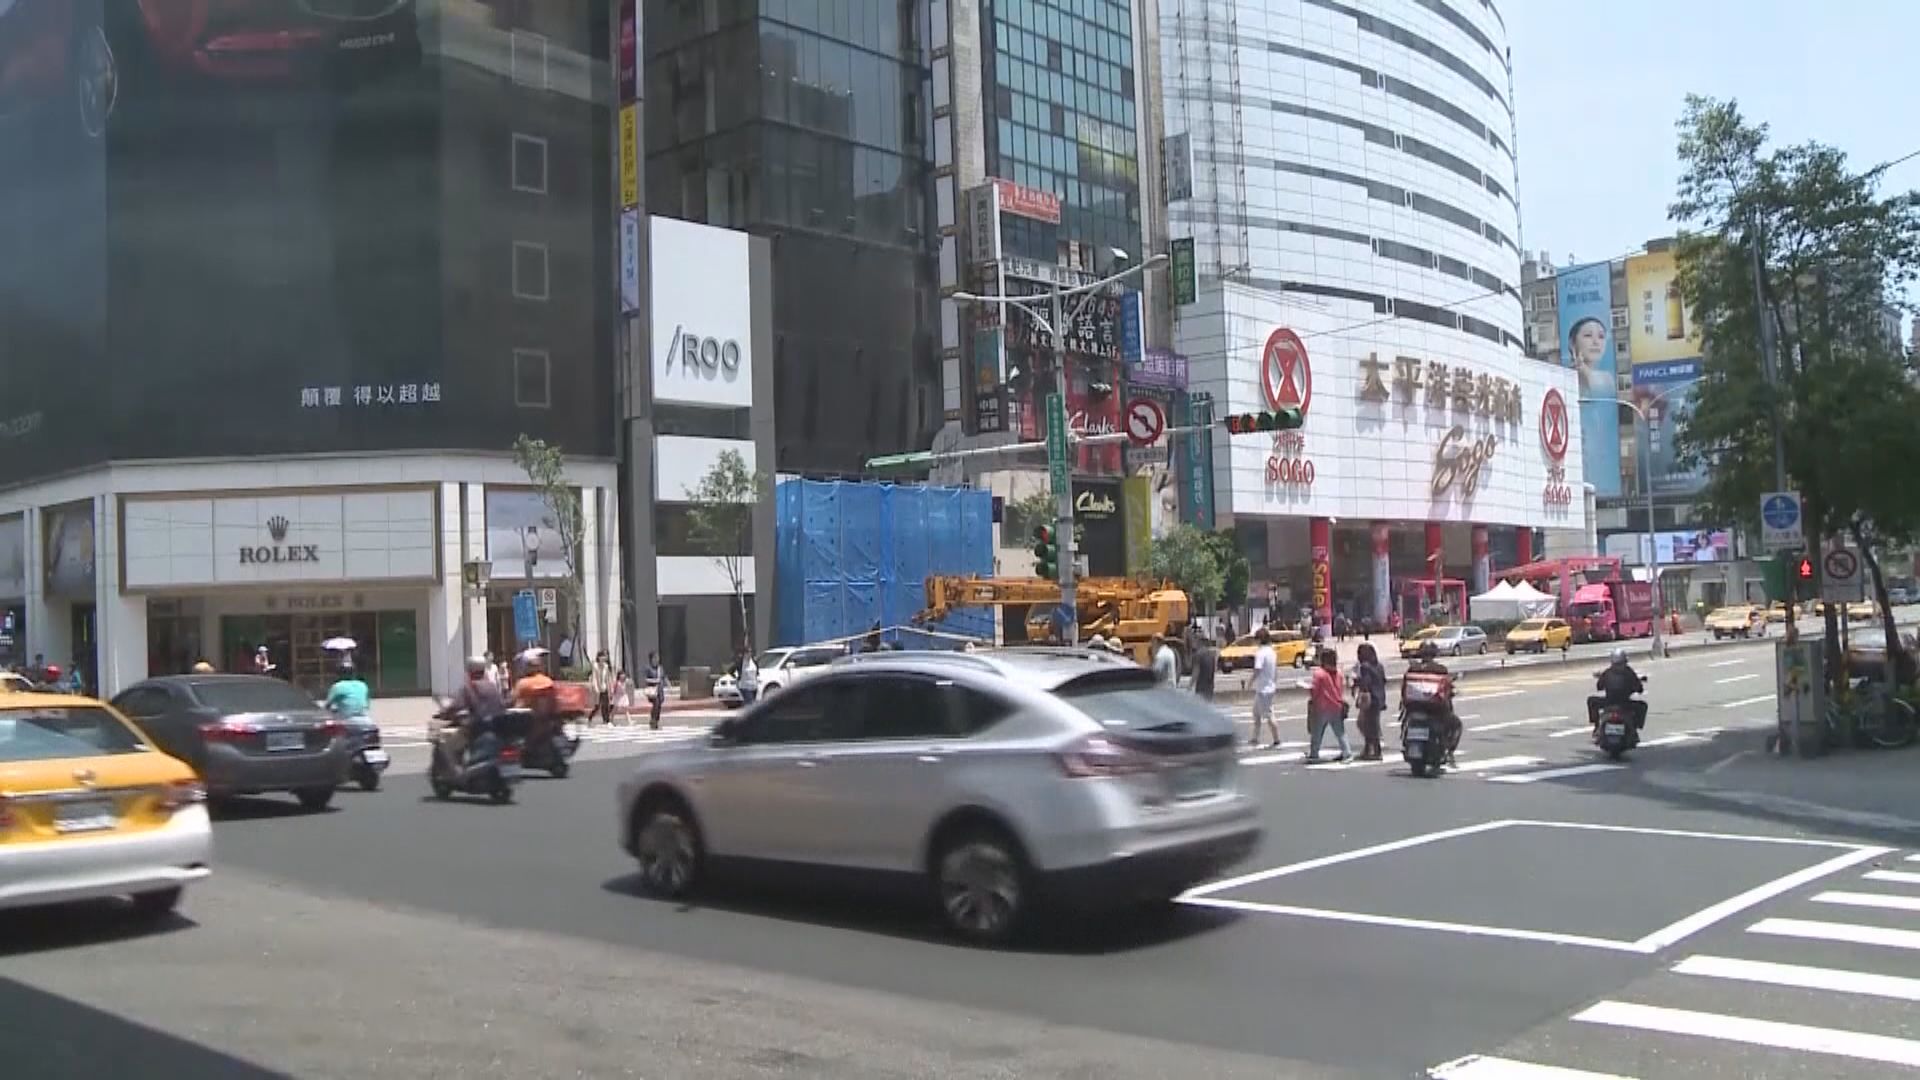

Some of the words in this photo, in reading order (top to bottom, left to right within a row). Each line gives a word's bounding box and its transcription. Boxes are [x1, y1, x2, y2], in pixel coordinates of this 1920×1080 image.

[300, 387, 342, 406] 顛覆
[354, 383, 441, 405] 得以超越
[1068, 411, 1116, 435] Clarks
[1267, 456, 1315, 484] SOGO
[1432, 425, 1497, 497] Sogo
[1075, 490, 1116, 513] Clarks
[1543, 484, 1572, 505] SOGO
[239, 545, 320, 564] ROLEX
[1311, 561, 1328, 608] Sale
[287, 596, 344, 608] ROLEX
